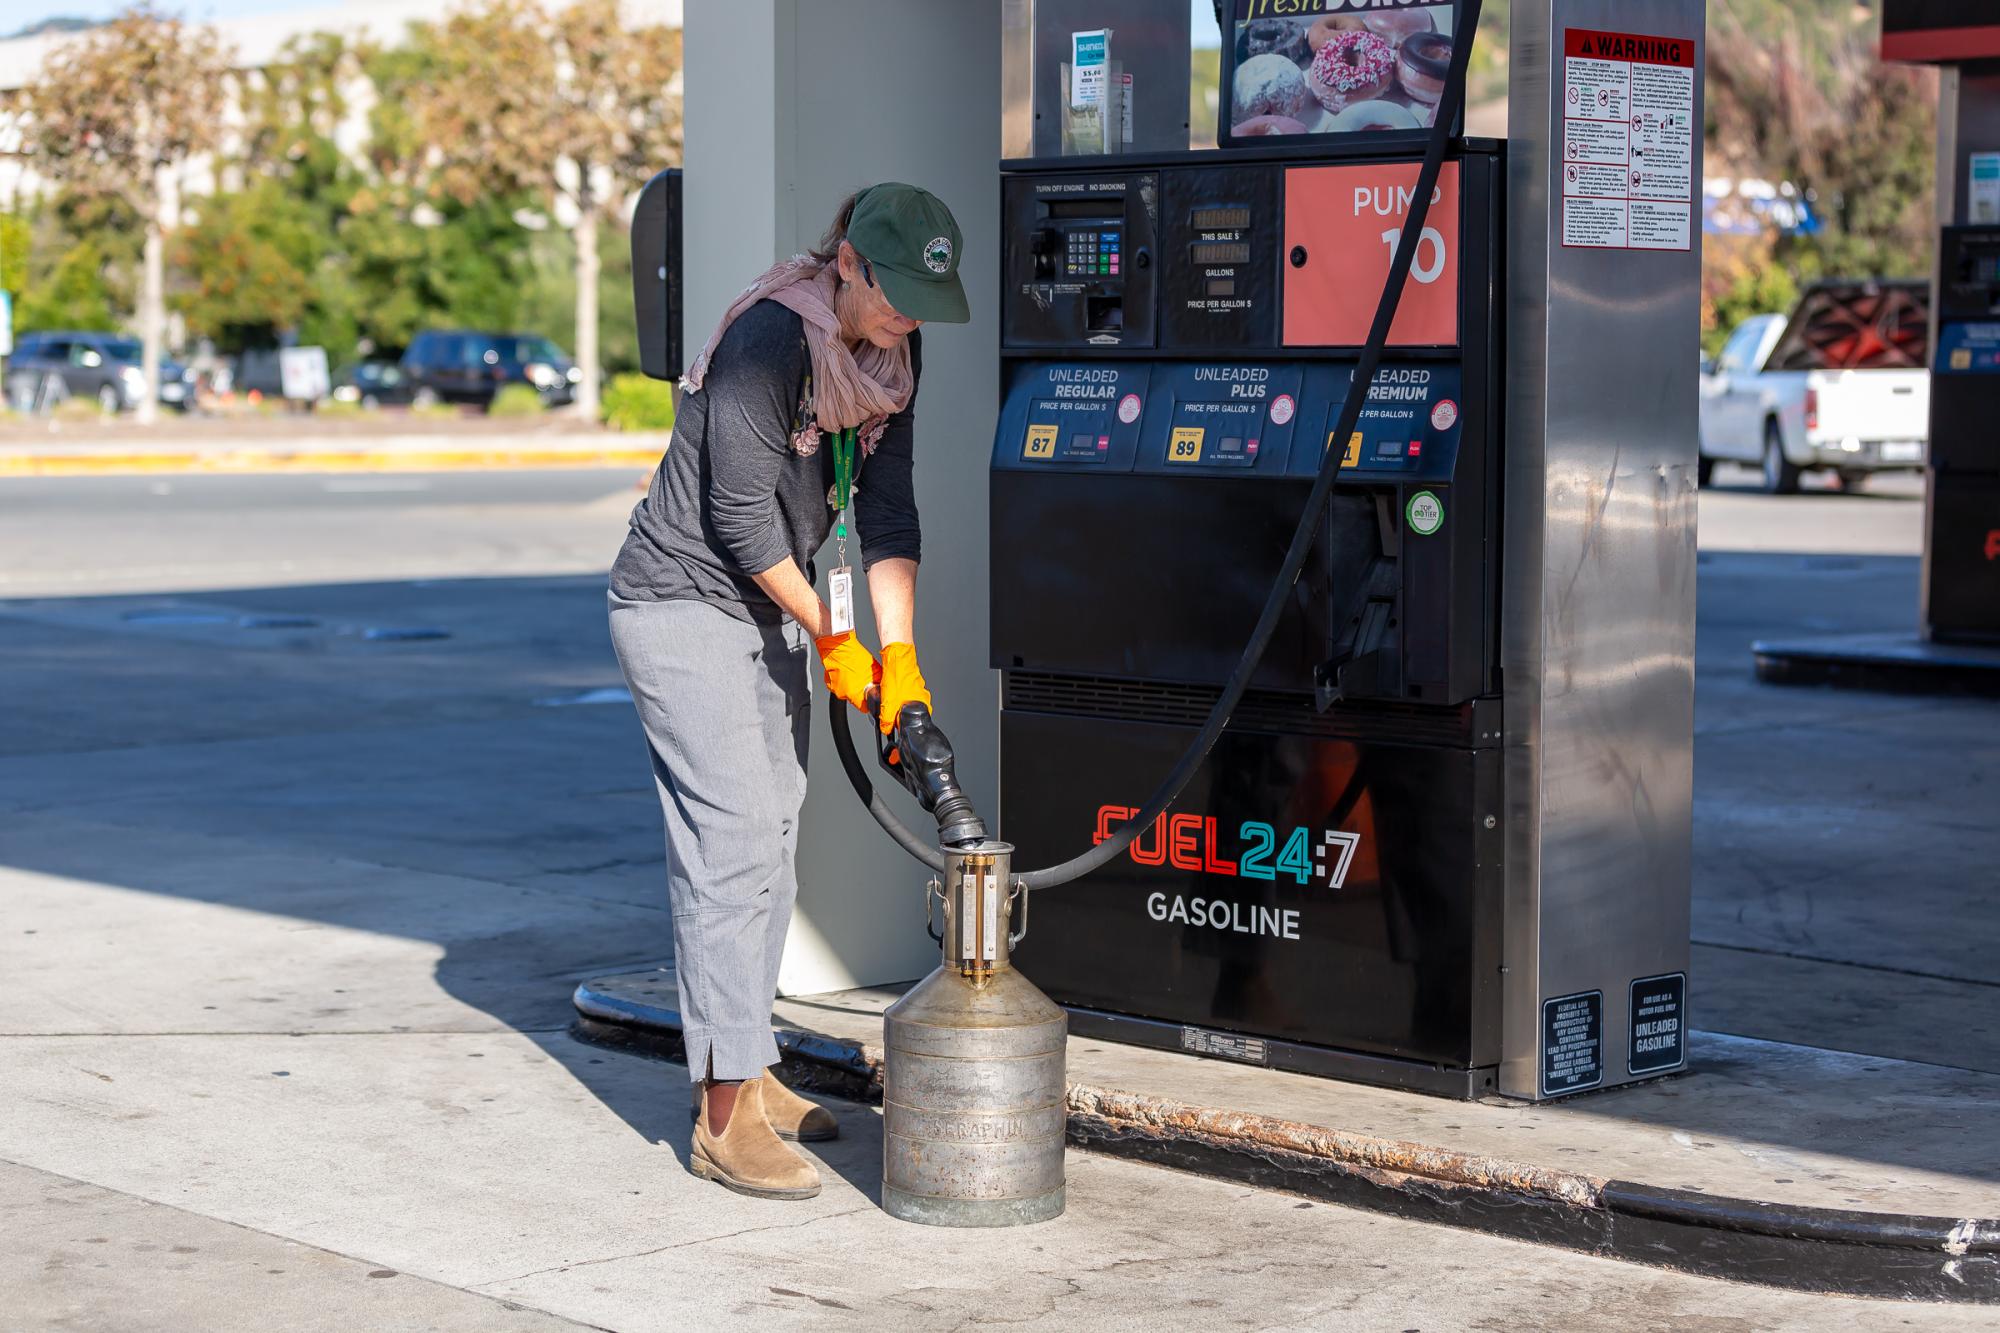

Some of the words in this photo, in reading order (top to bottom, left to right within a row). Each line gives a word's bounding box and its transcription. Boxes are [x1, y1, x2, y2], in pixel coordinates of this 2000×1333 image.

[1597, 36, 1681, 62] WARNING
[1381, 226, 1446, 284] 10
[1049, 369, 1118, 382] UNLEADED
[1194, 368, 1268, 381] UNLEADED
[1350, 369, 1430, 384] LEADED
[1055, 385, 1116, 398] REGULAR
[1231, 384, 1266, 398] PLUS
[1366, 386, 1428, 400] REMIUM
[1221, 405, 1248, 413] GALLON
[1250, 405, 1256, 413] $
[1031, 438, 1050, 453] 87
[1176, 441, 1195, 456] 89
[1147, 892, 1300, 940] GASOLINE
[1643, 996, 1653, 1004] FOR
[1556, 1010, 1580, 1020] PROHIBITS
[1639, 1007, 1654, 1016] MOTOR
[1655, 1006, 1665, 1014] FUEL
[1666, 1003, 1676, 1012] ONLY
[1553, 1017, 1585, 1029] INTRODUCTION
[1567, 1025, 1589, 1034] GASOLINE
[1636, 1018, 1678, 1037] UNLEADED
[1559, 1033, 1586, 1044] CONTAINING
[1636, 1034, 1676, 1053] GASOLINE
[1548, 1046, 1559, 1055] LEAD
[1554, 1054, 1564, 1062] INTO
[1576, 1048, 1592, 1057] MOTOR
[1554, 1060, 1572, 1070] VEHICLE
[933, 1119, 1023, 1140] SERAPHIN
